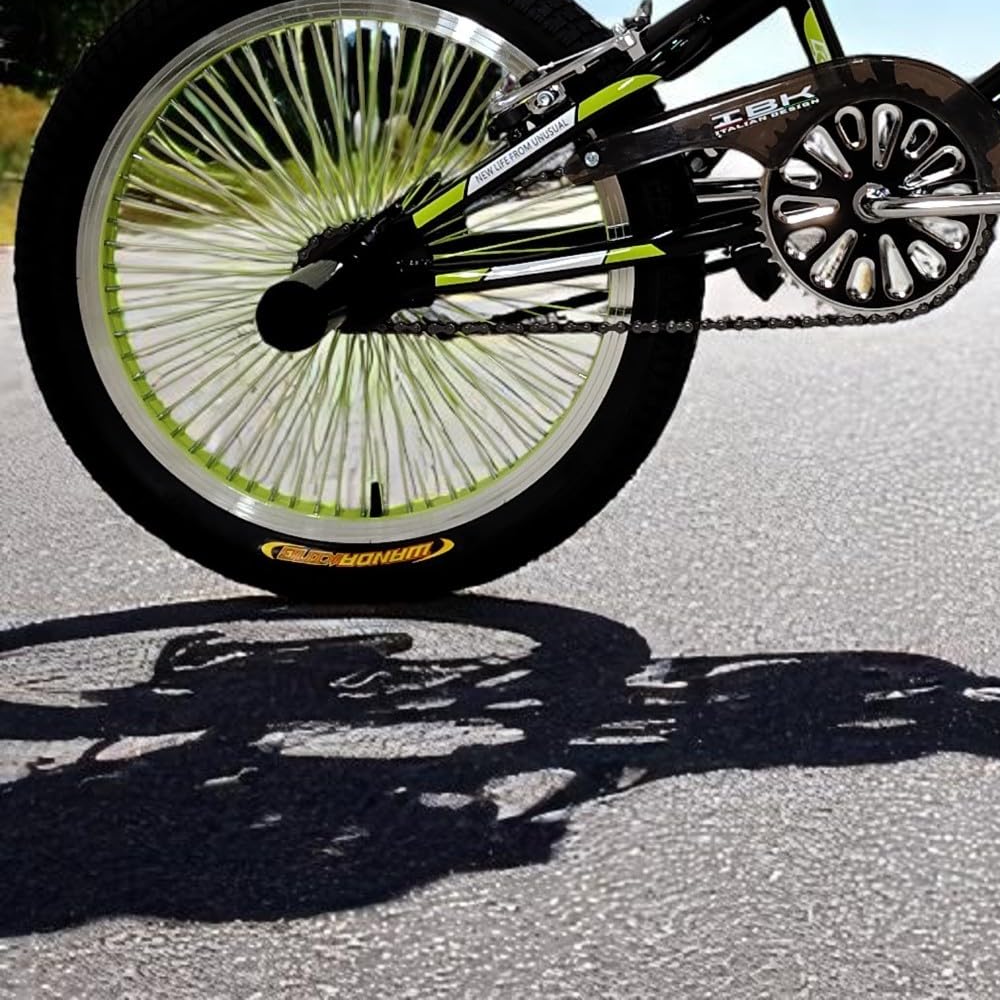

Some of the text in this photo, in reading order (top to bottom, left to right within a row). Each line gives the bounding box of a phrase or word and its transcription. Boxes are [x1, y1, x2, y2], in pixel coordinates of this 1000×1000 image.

[711, 85, 816, 129] IBK
[714, 98, 820, 138] ITALIAN DESIGN
[475, 118, 570, 184] NEW LIFE FROM UNUSUAL
